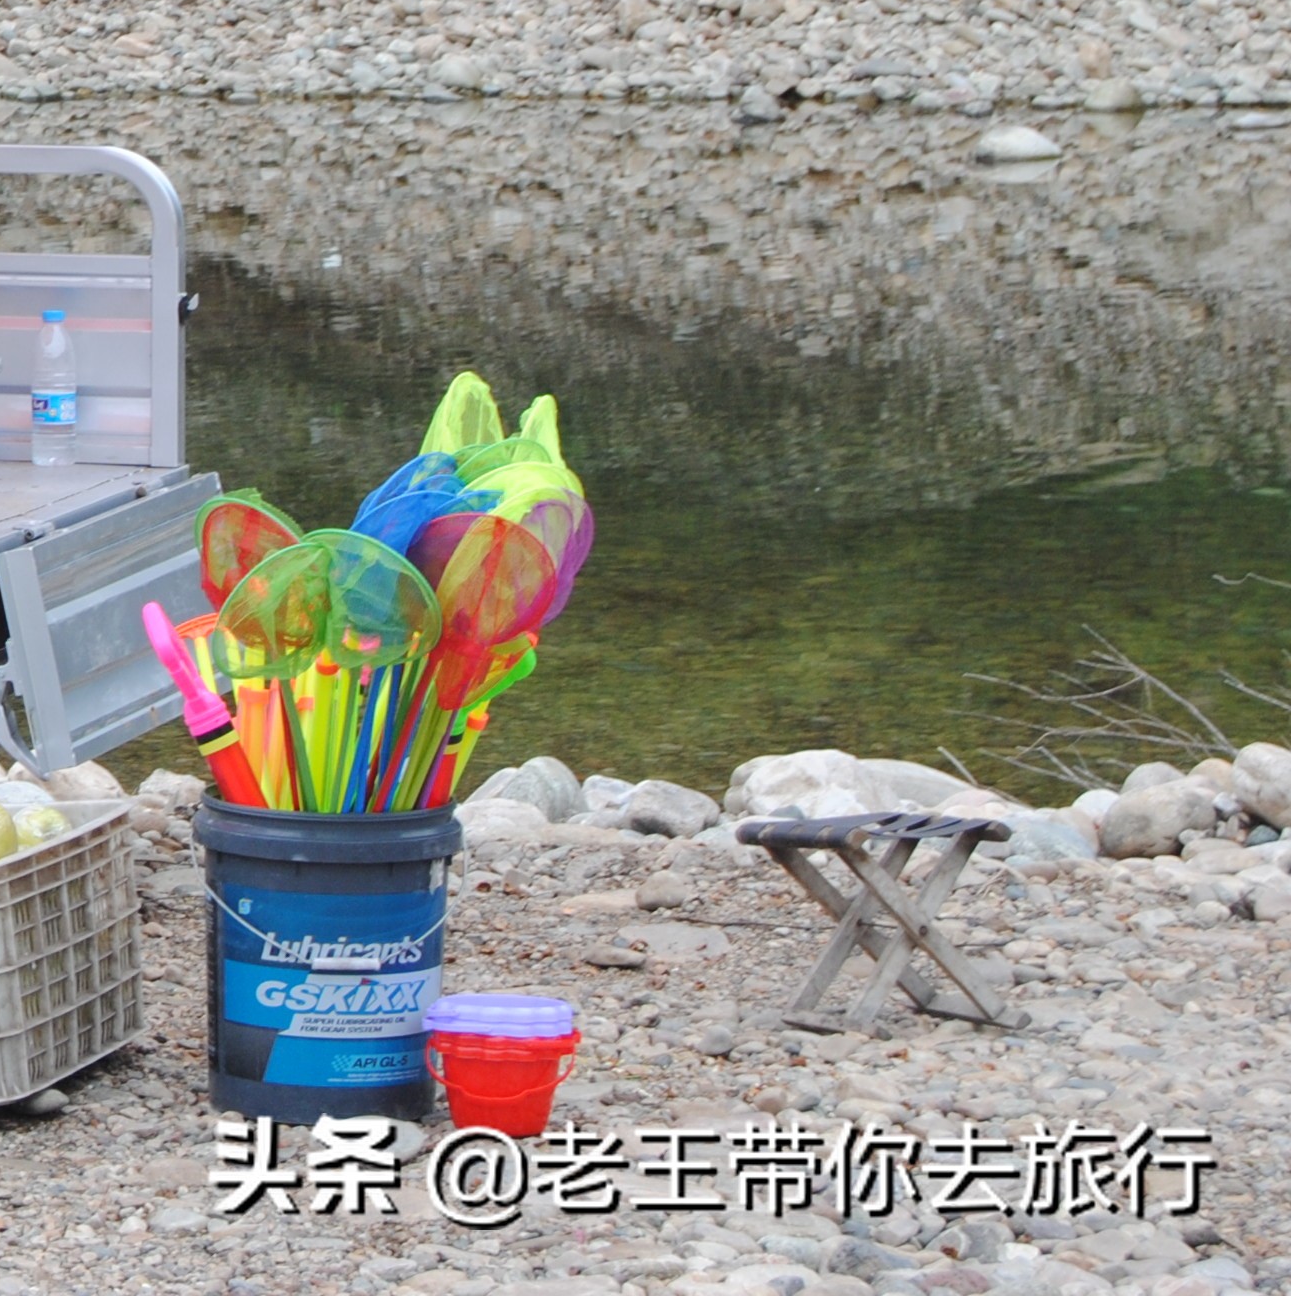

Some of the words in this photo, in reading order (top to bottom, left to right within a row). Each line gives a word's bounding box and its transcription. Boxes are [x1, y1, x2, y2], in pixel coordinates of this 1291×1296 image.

[261, 932, 425, 966] Lubricants
[300, 1025, 318, 1033] FOR
[352, 1057, 377, 1068] API
[379, 1055, 409, 1067] GL-5
